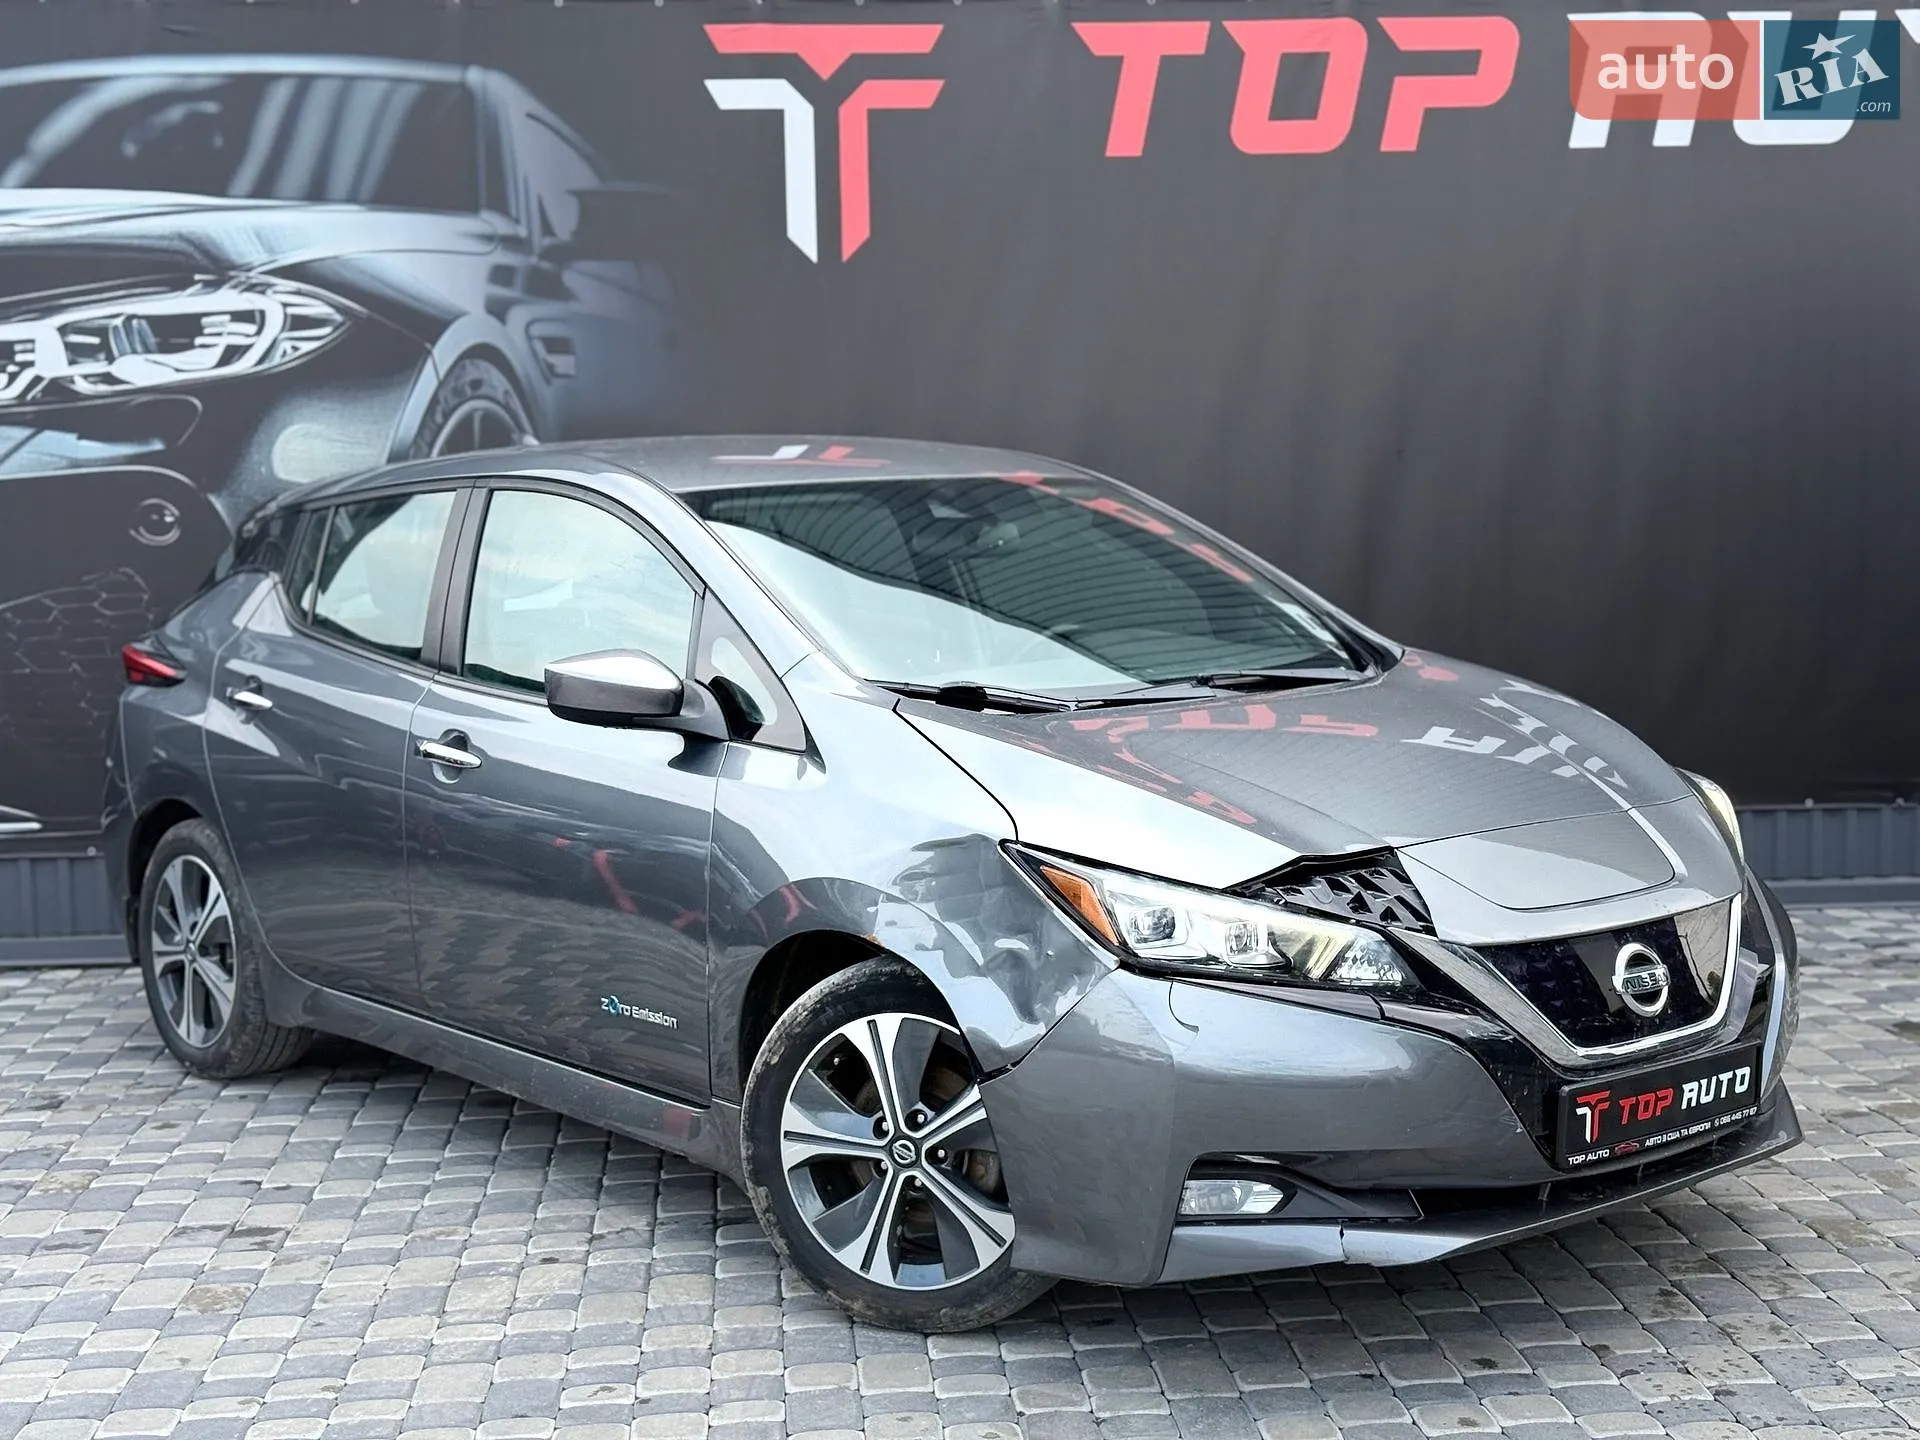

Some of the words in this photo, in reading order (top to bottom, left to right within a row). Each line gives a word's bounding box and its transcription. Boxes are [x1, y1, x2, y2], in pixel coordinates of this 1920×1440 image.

[1071, 16, 1521, 157] TOP
[1566, 9, 1920, 148] AU
[1623, 970, 1669, 993] NISSAN
[632, 1006, 678, 1029] Emission
[1619, 1088, 1674, 1125] TOP
[1681, 1066, 1751, 1110] AUTO
[1568, 1153, 1586, 1165] TOP
[1586, 1149, 1610, 1162] AUTO
